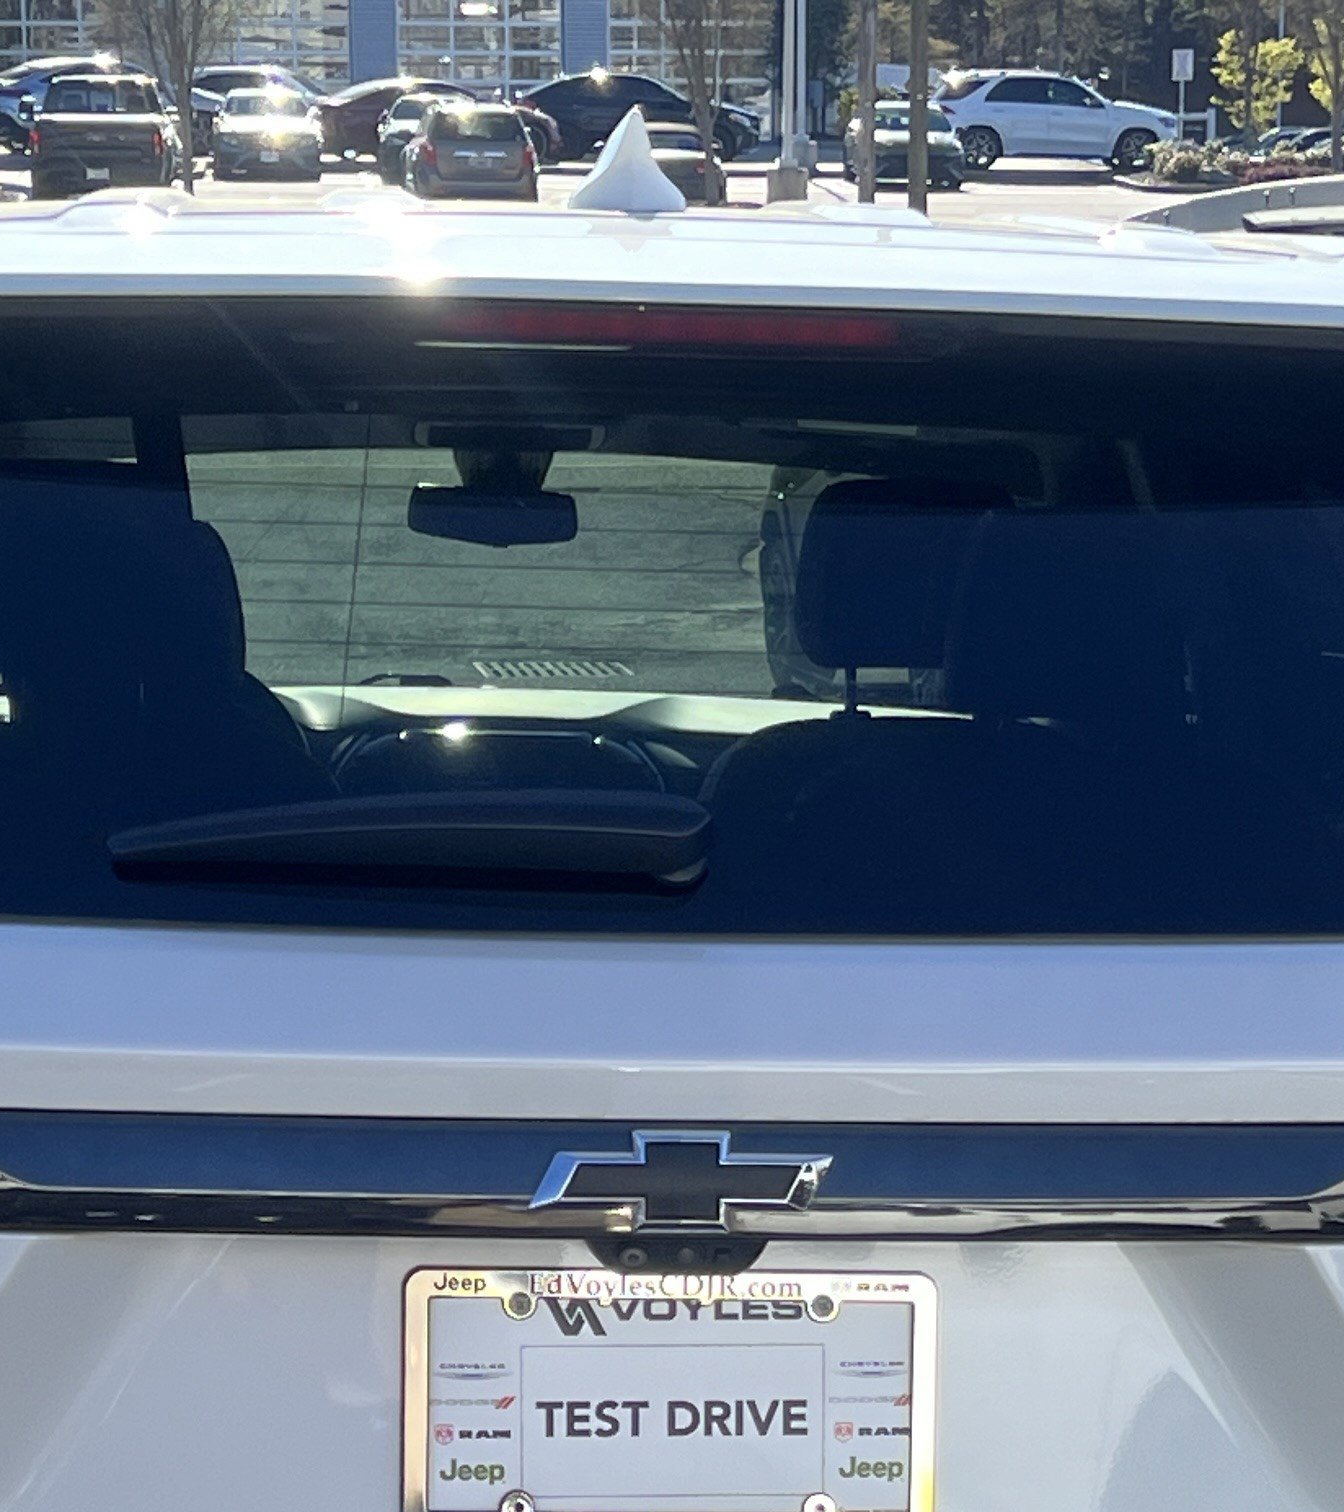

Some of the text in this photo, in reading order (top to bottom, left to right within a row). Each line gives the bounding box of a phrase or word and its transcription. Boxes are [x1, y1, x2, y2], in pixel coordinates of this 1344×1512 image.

[433, 1272, 487, 1294] Jeep
[529, 1272, 803, 1299] EdVoylesCDJR.com
[535, 1399, 809, 1438] TEST DRIVE
[858, 1426, 911, 1437] RAM
[458, 1429, 512, 1440] RAM
[439, 1458, 506, 1485] Jeep
[838, 1456, 904, 1482] Jeep
